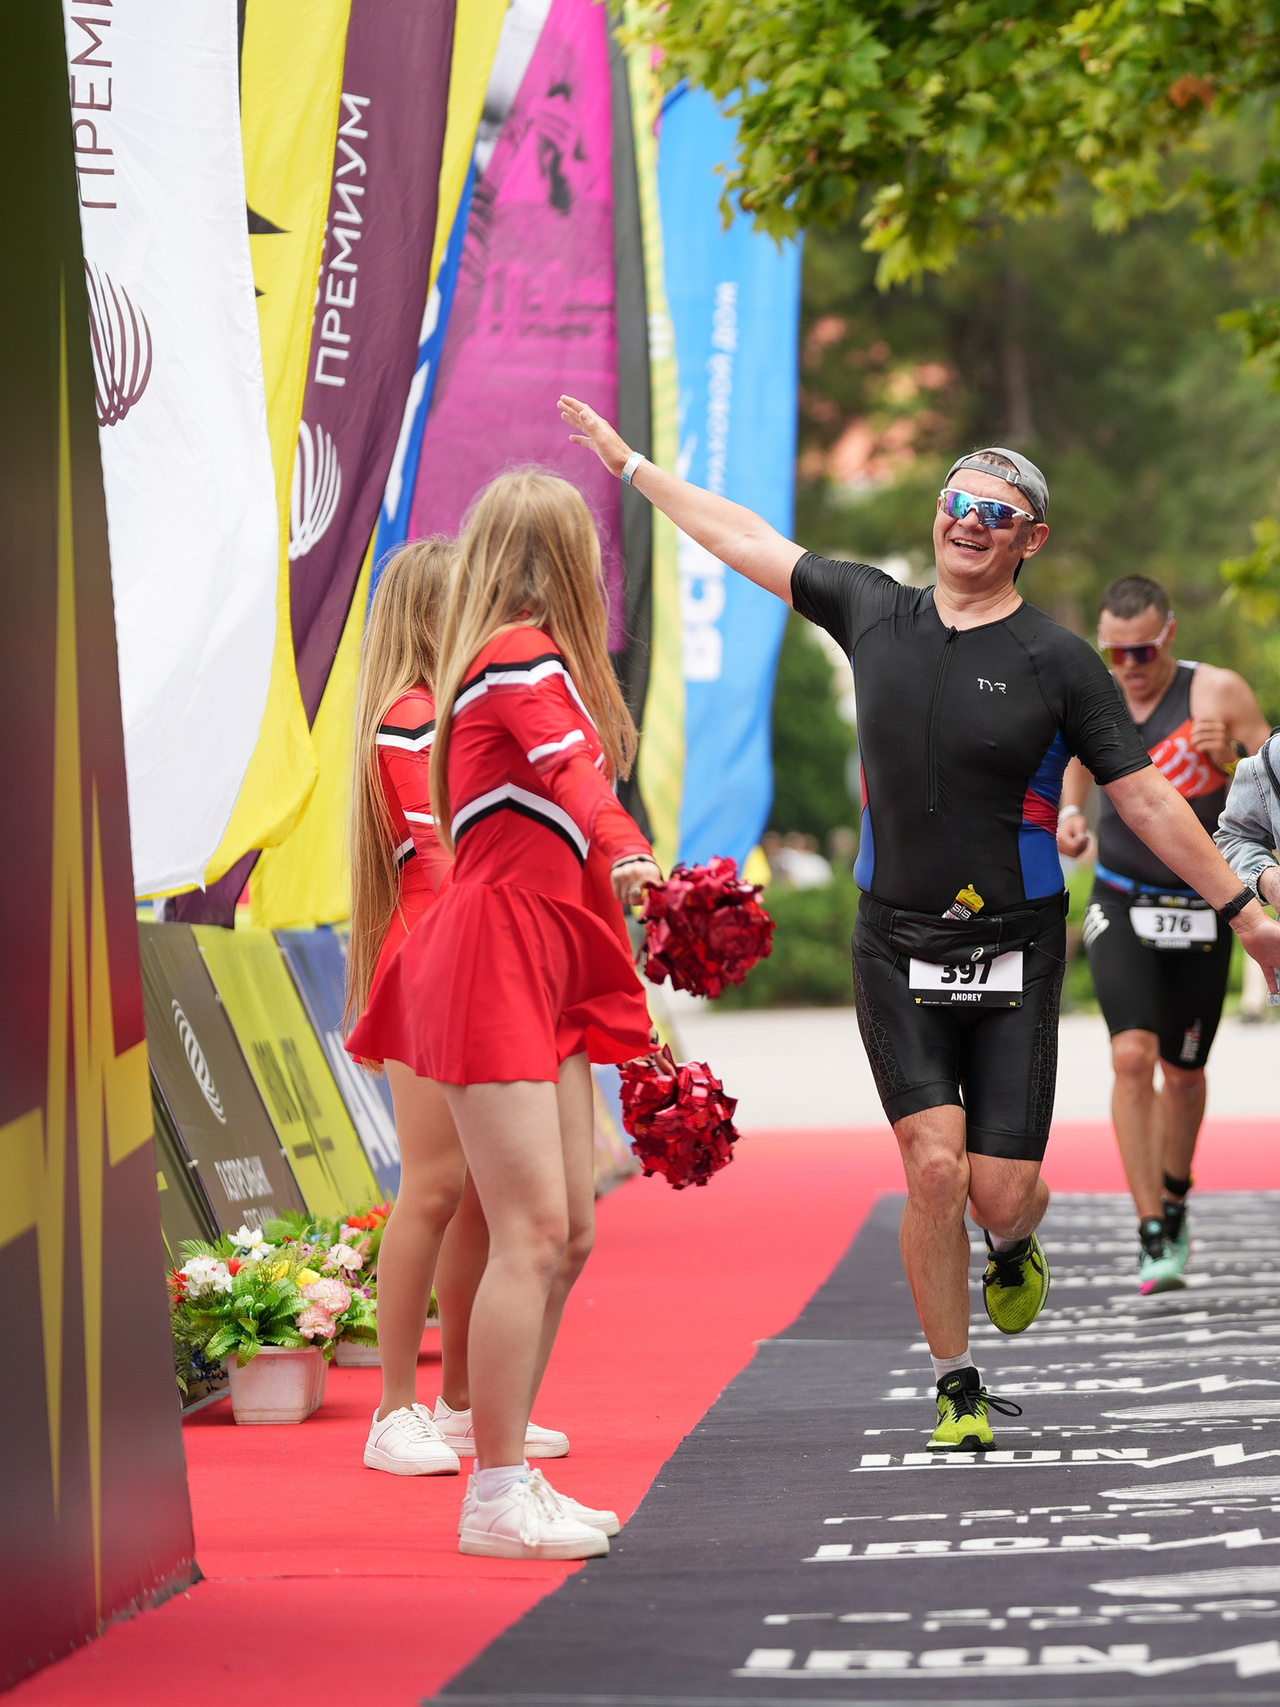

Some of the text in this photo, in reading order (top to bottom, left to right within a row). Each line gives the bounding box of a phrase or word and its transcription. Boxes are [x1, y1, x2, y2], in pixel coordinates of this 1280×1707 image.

[71, 0, 117, 209] ПРЕМ
[314, 92, 370, 387] ПРЕМИУМ
[1155, 914, 1192, 933] 376
[941, 960, 993, 985] 397
[951, 993, 982, 1002] ANDREY
[889, 1377, 1144, 1396] ION
[859, 1447, 1149, 1467] IRON
[814, 1533, 1151, 1557] IRON
[744, 1644, 1150, 1671] IRON
